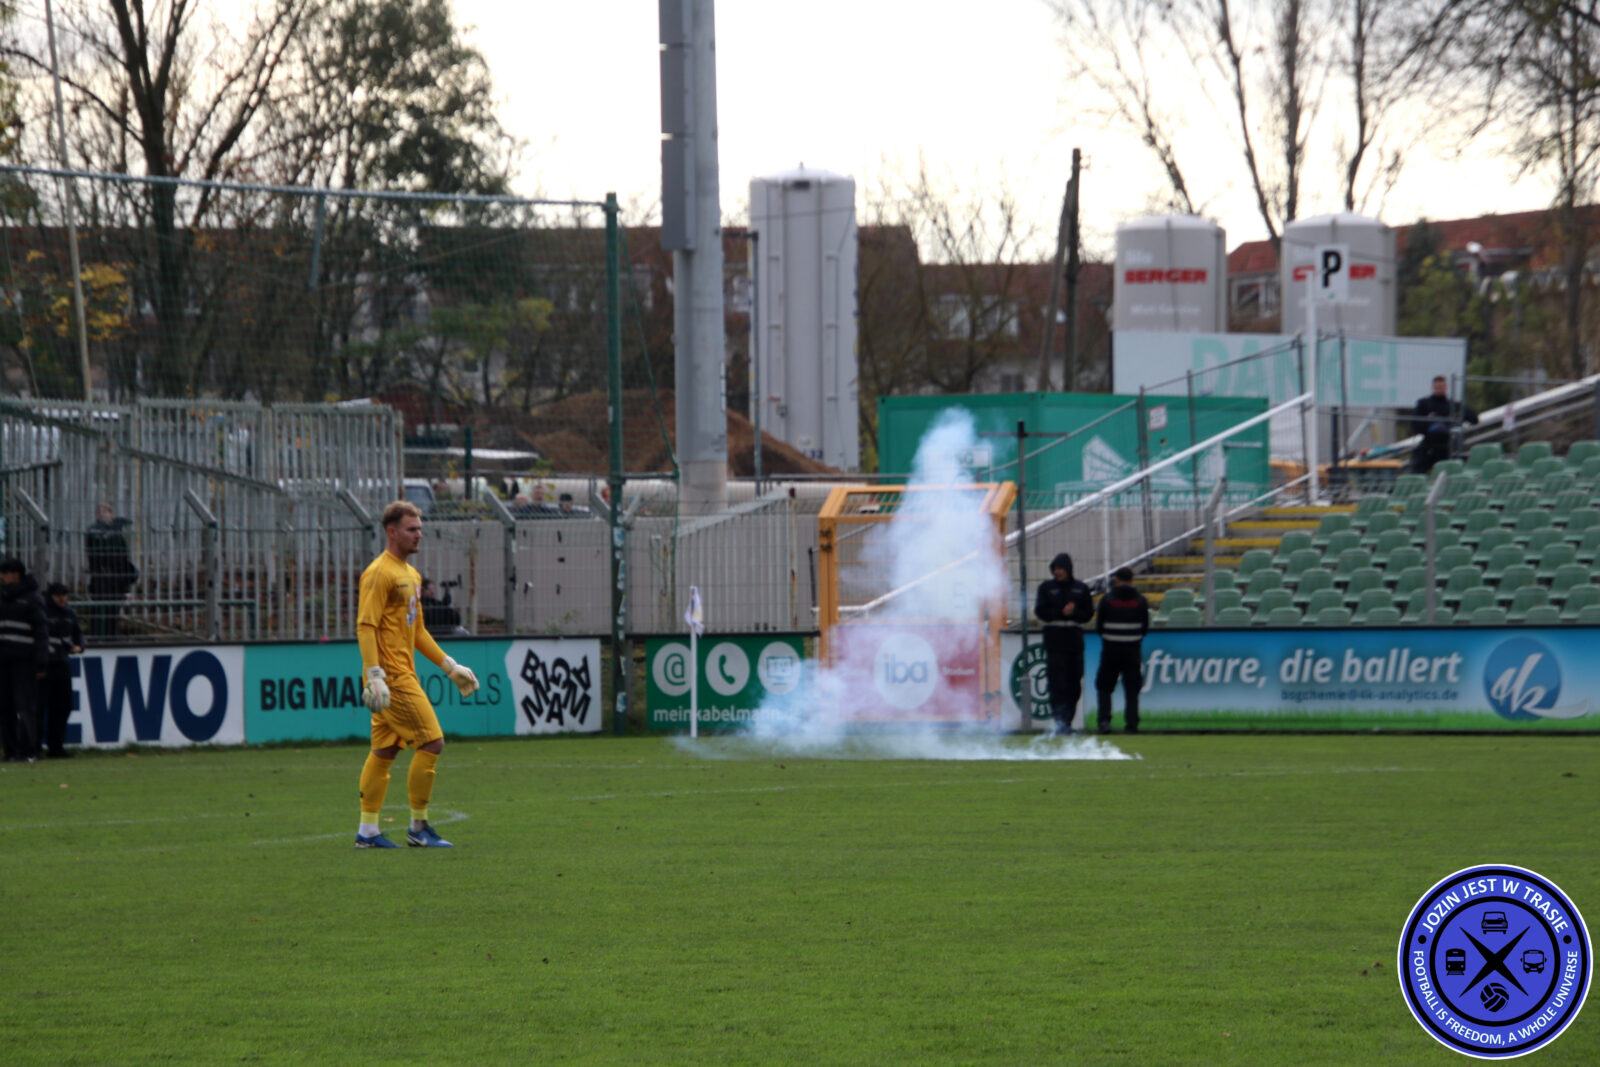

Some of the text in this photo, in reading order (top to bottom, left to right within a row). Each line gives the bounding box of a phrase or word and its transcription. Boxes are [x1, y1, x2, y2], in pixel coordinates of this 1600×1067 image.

[1125, 269, 1207, 284] BERGER
[1322, 250, 1342, 288] P
[884, 653, 928, 683] iba
[1141, 648, 1463, 692] ftware, die ballert
[260, 677, 305, 711] BIG
[312, 676, 365, 709] MA
